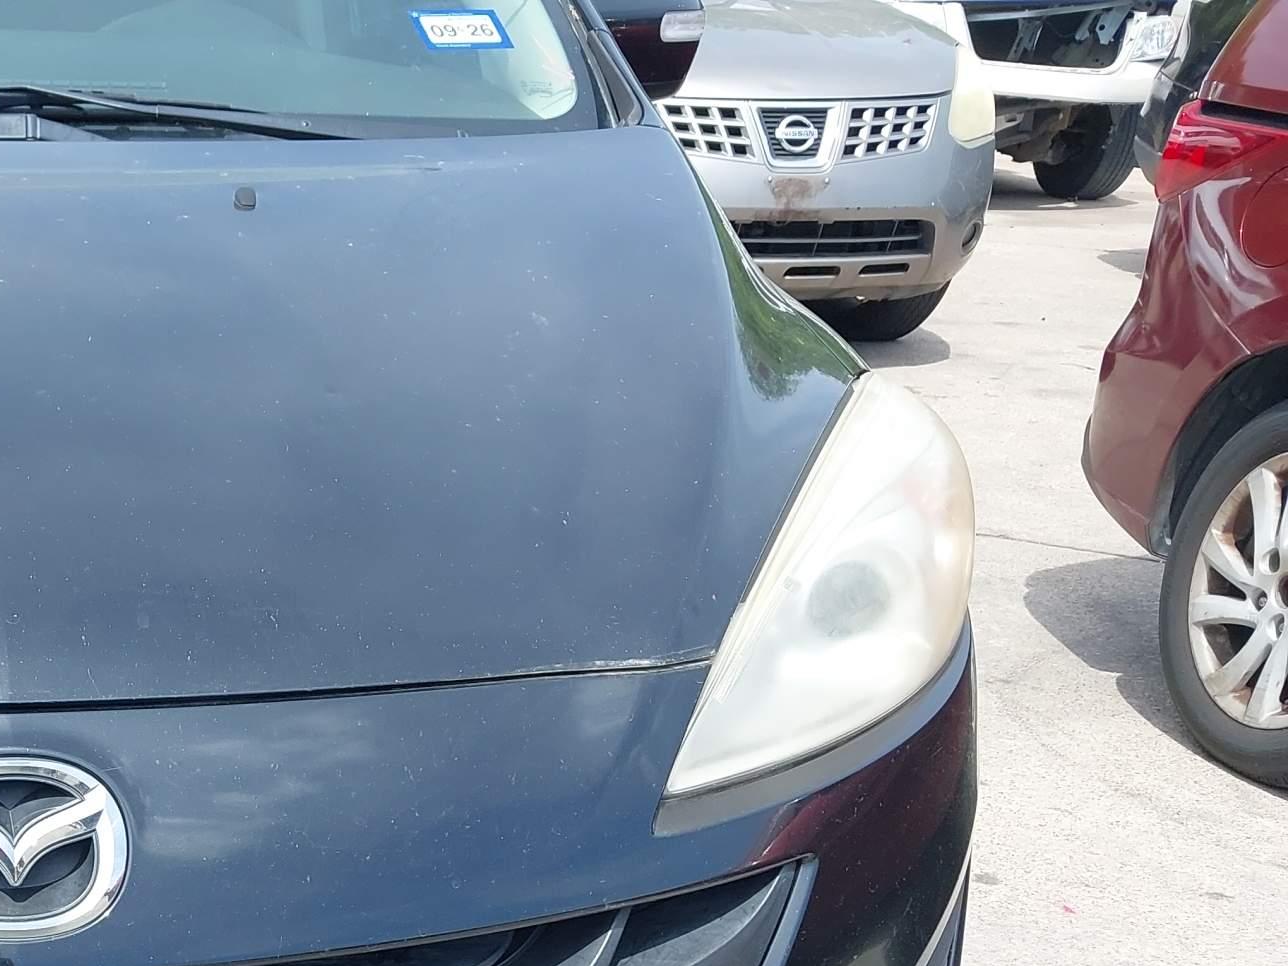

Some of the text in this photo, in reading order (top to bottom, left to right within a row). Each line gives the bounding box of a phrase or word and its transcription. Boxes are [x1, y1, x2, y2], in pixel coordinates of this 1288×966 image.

[430, 23, 494, 38] 09 26
[781, 129, 815, 137] NISSAN
